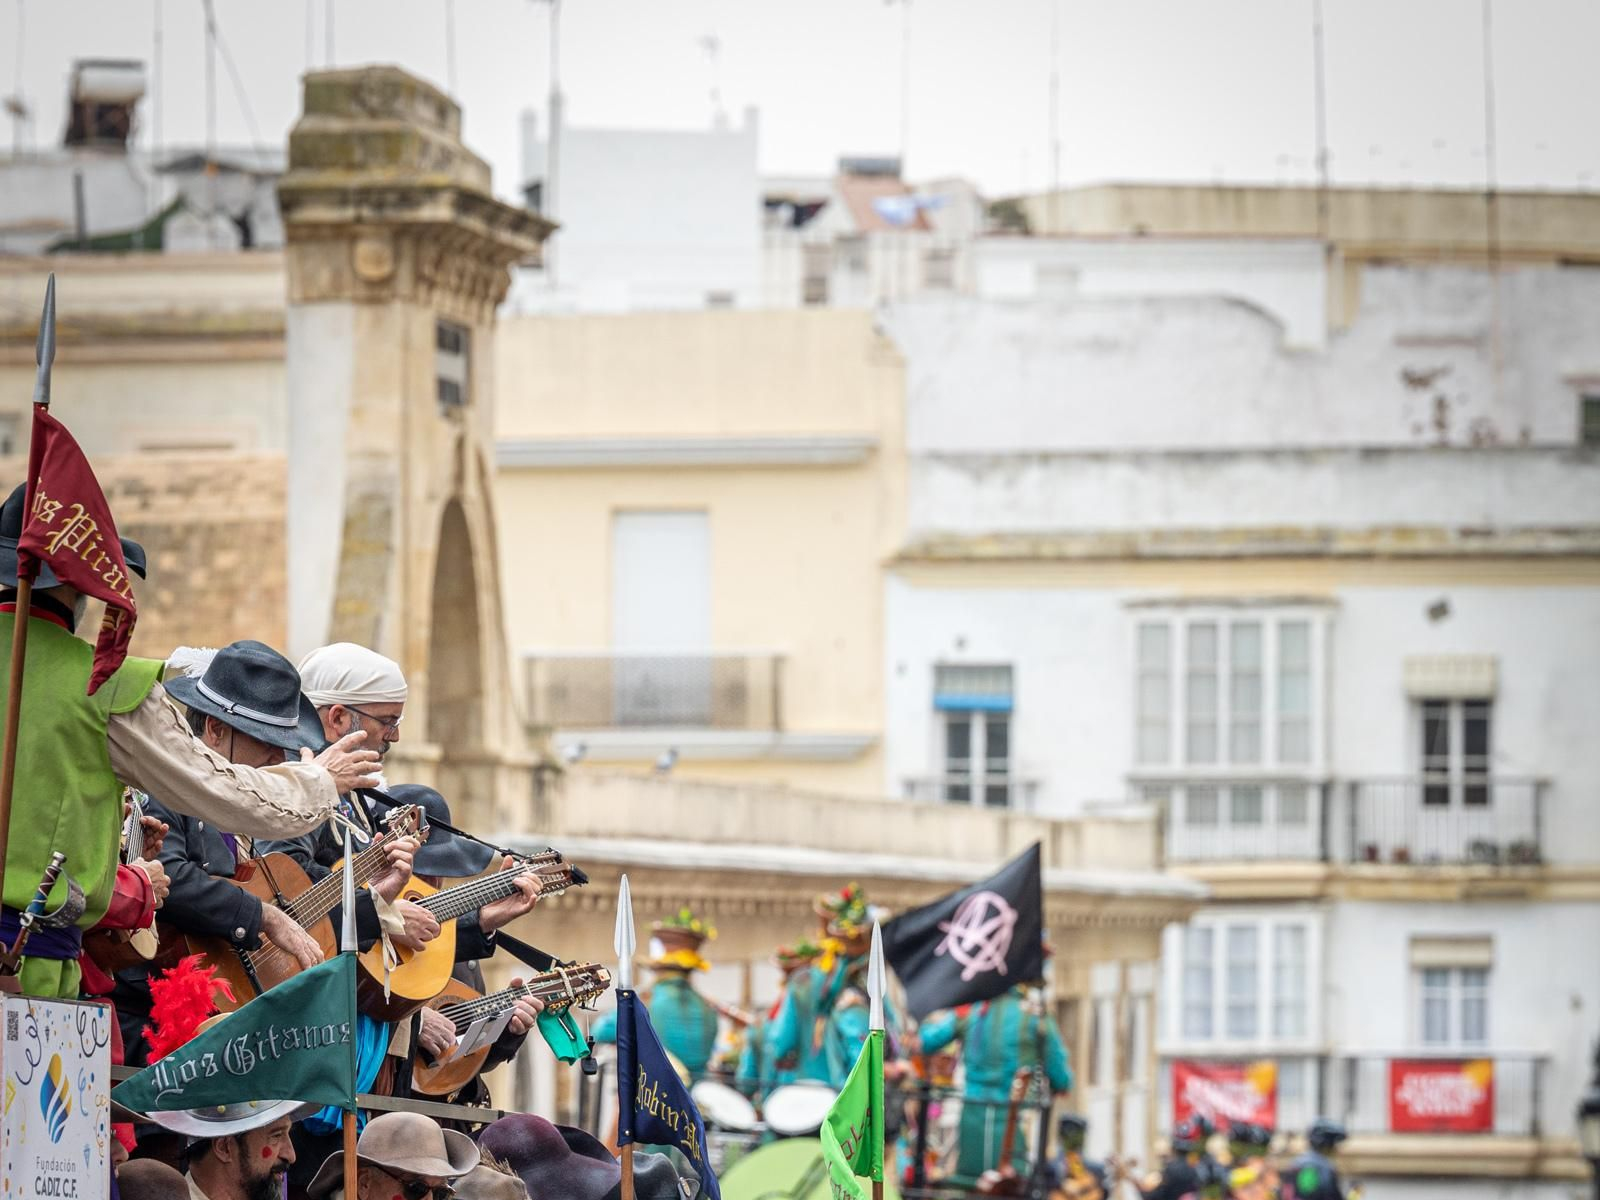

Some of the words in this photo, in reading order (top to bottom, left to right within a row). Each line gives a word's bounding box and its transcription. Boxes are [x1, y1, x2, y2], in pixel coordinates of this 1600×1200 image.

[151, 1052, 219, 1110] Los
[223, 1022, 351, 1076] Gitanos
[635, 1063, 679, 1132] Robin
[36, 1155, 77, 1173] Fundación
[63, 1177, 78, 1199] C.F.
